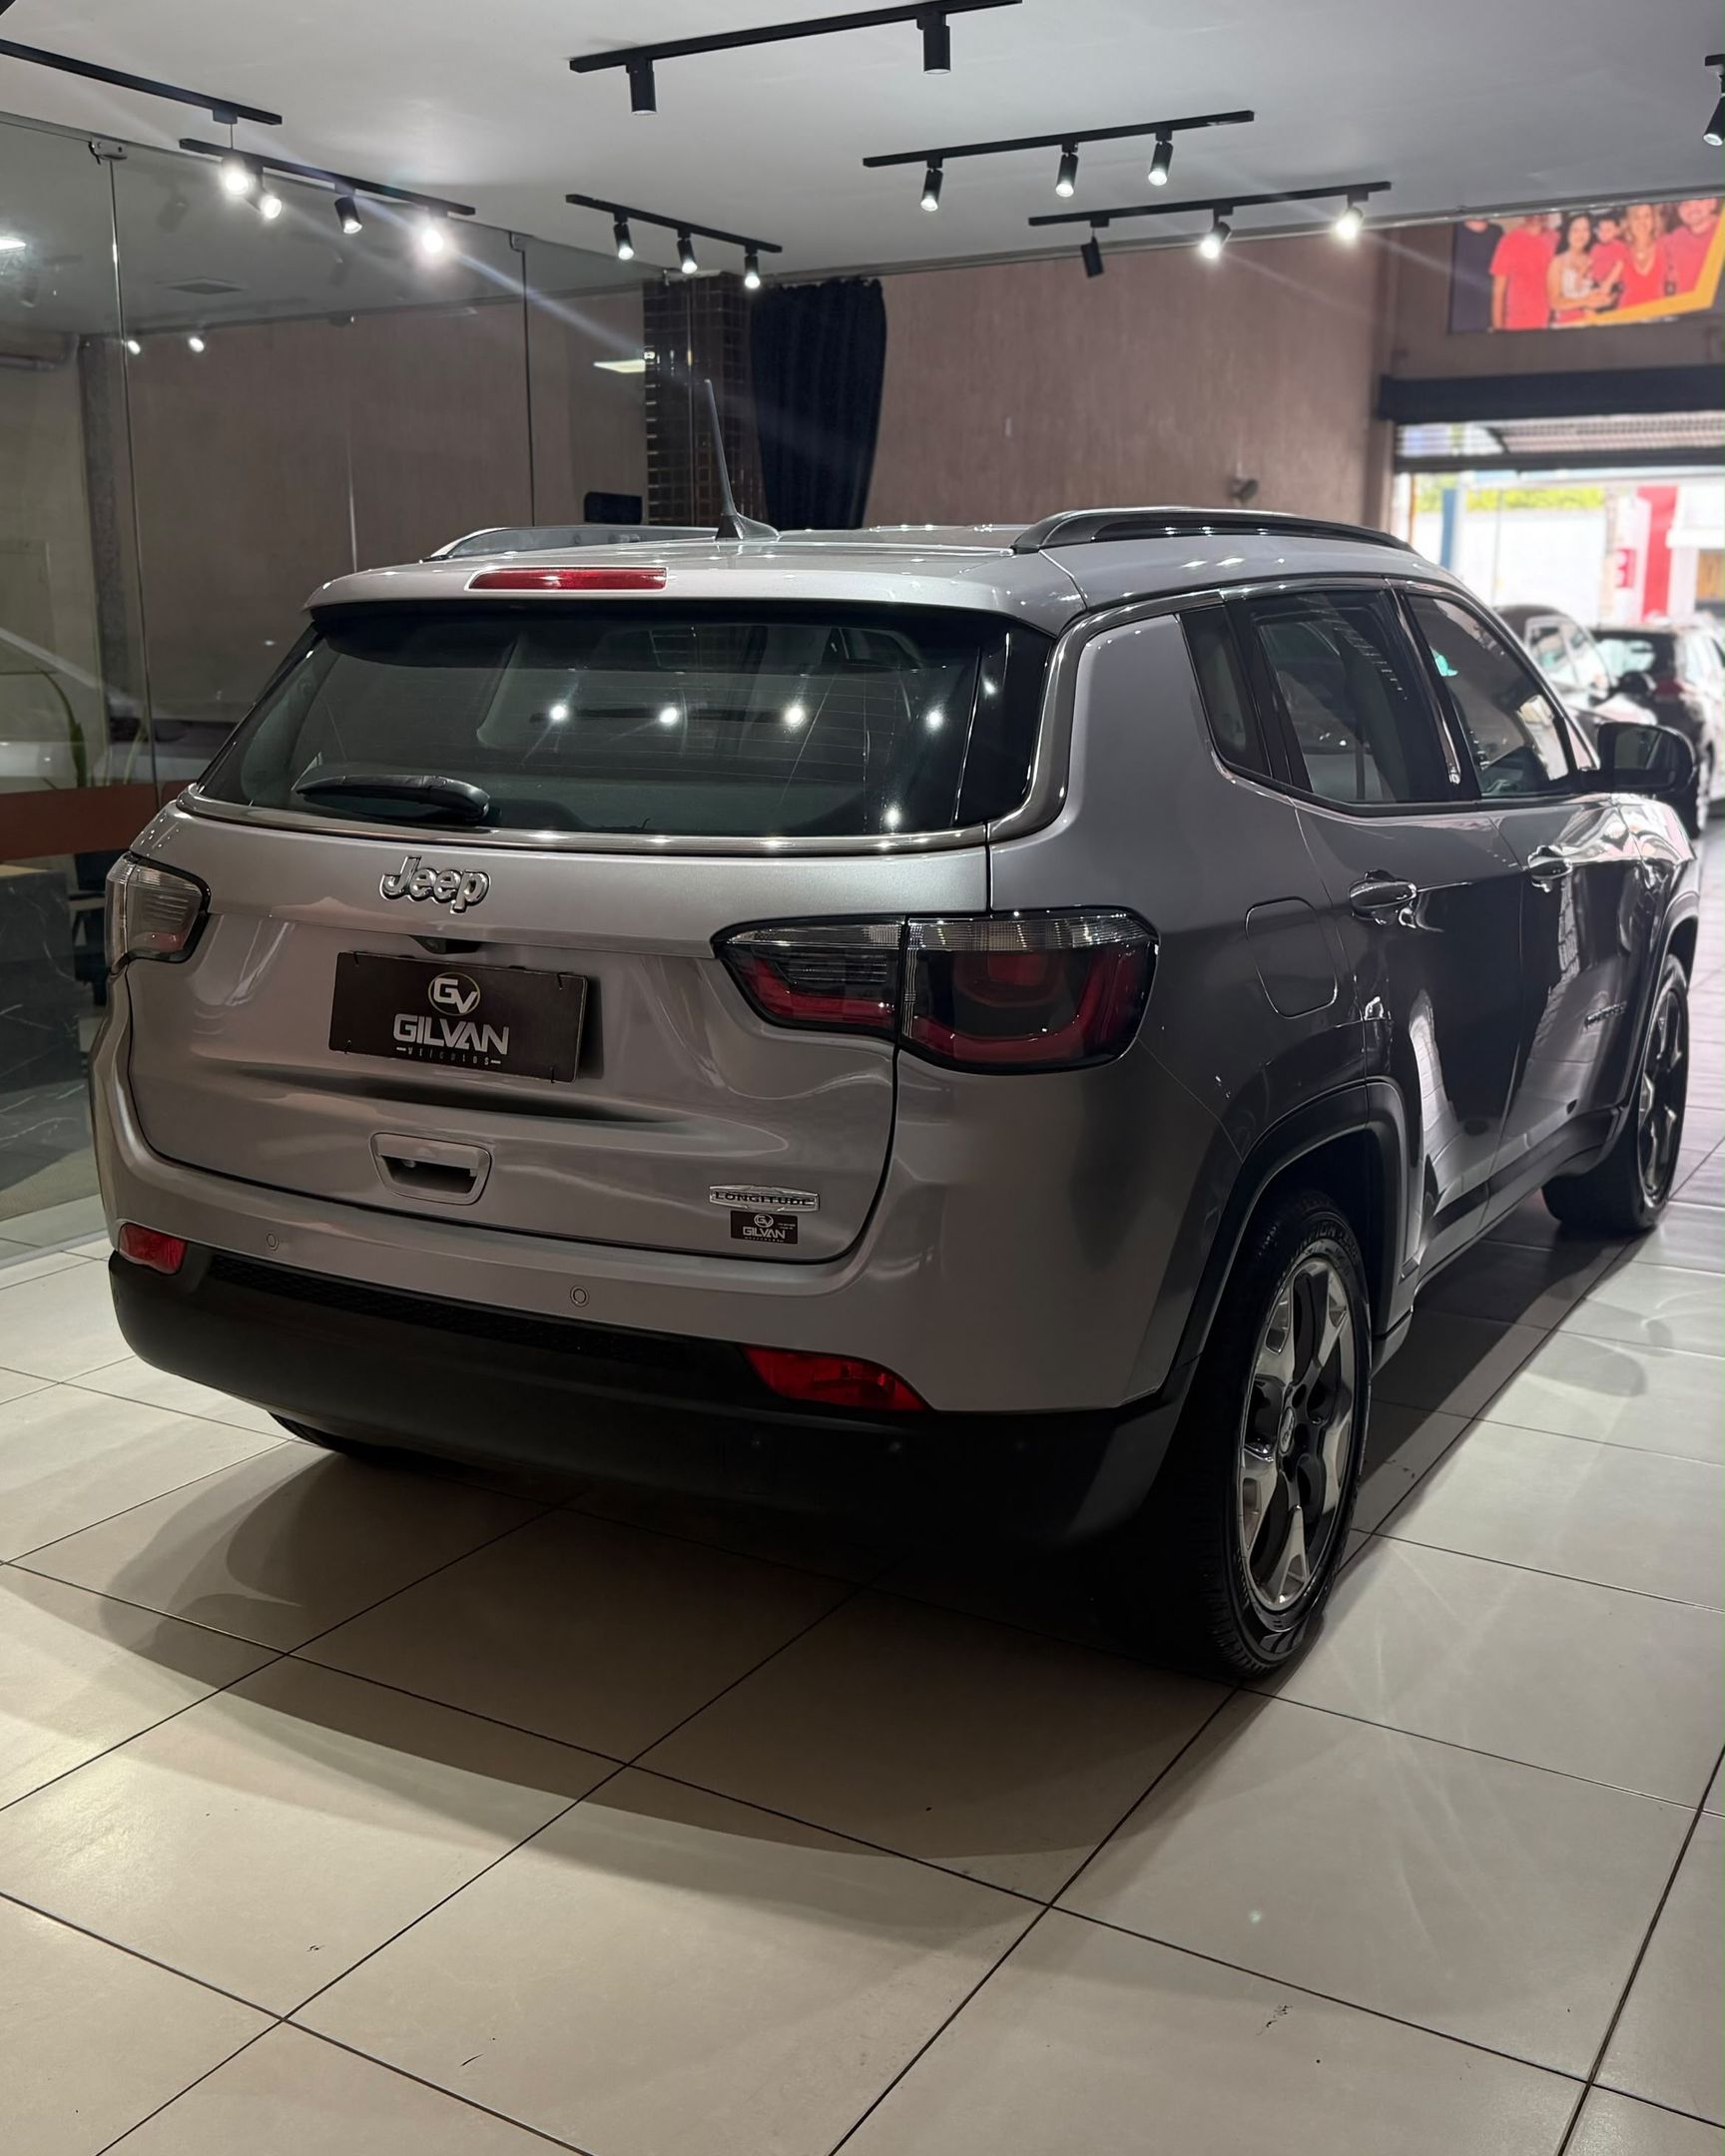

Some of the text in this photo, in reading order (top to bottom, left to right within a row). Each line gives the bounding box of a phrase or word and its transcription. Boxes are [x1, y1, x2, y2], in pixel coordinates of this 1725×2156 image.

[379, 855, 491, 914] Jeep
[392, 1013, 509, 1055] GILVAN
[714, 1191, 816, 1206] LONGITUDE
[743, 1226, 786, 1240] GILVAN
